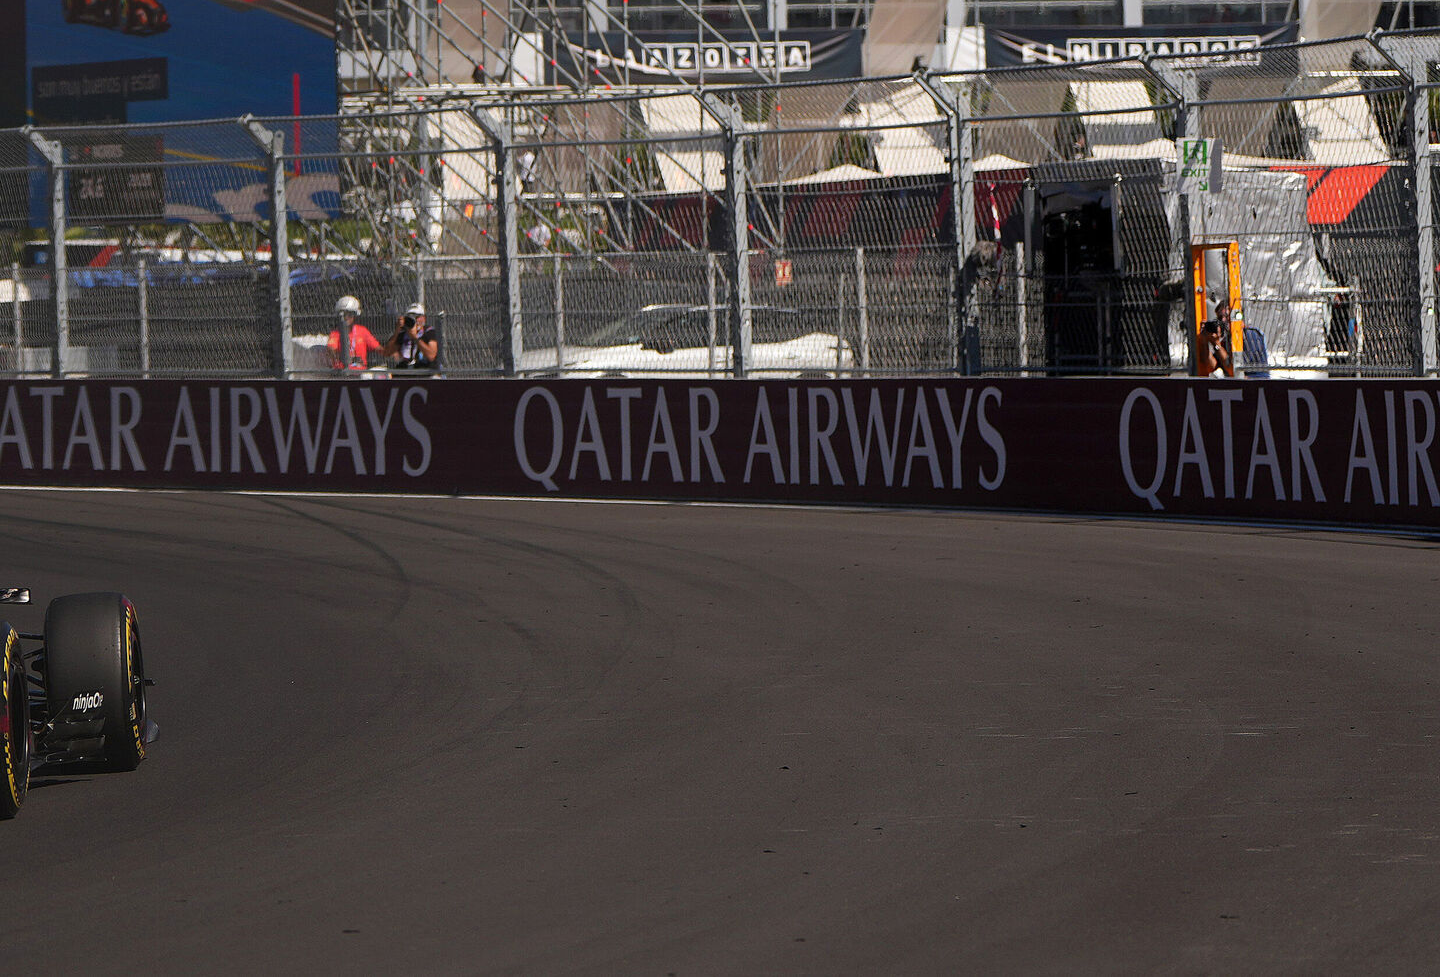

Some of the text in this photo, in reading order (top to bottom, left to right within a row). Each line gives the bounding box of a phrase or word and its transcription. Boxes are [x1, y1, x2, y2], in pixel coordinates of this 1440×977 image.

[1021, 42, 1059, 64] EL
[1181, 168, 1209, 178] EXIT
[163, 385, 433, 477] AIRWAYS
[514, 386, 1007, 492] QATAR AIRWAYS
[1119, 387, 1440, 510] QATAR AIR
